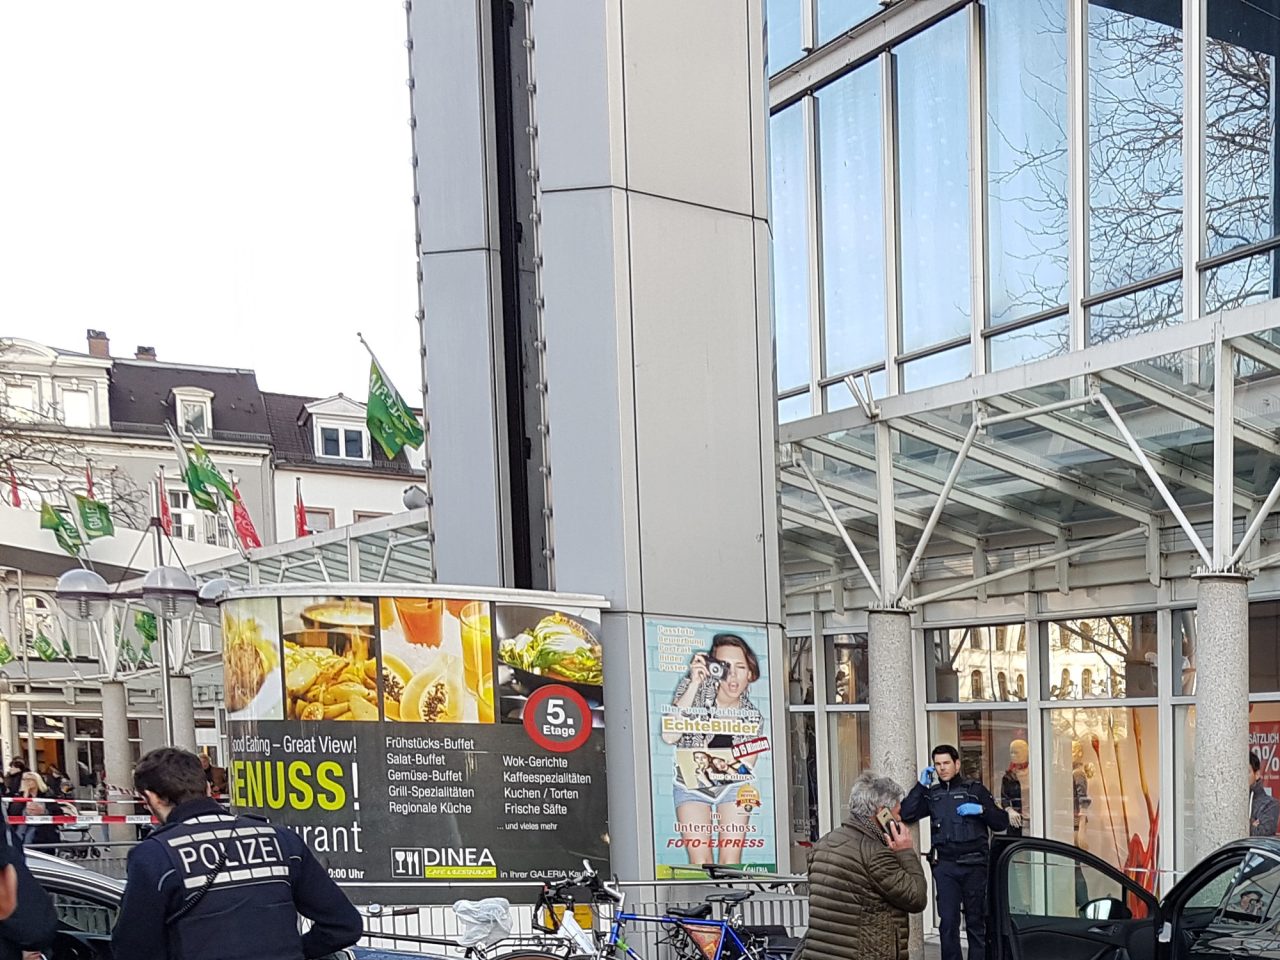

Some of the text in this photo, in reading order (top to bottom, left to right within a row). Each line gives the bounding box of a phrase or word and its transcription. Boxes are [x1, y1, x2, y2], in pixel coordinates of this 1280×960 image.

[546, 699, 575, 725] 5.
[543, 725, 576, 738] Etage
[246, 736, 271, 757] Eating
[283, 735, 317, 753] Great
[318, 735, 358, 754] View!
[385, 736, 475, 751] Frühstücks-Buffet
[386, 752, 446, 766] Salat-Buffet
[502, 755, 569, 769] Wok-Gerichte
[387, 769, 463, 782] Gemüse-Buffet
[503, 771, 592, 785] Kaffeespezialitäten
[388, 785, 475, 799] Grill-Spezialitäten
[504, 787, 541, 799] Kuchen
[550, 787, 579, 800] Torten
[389, 801, 472, 815] Regionale Küche
[505, 802, 568, 815] Frische Säfte
[520, 822, 540, 830] vieles
[540, 822, 558, 831] mehr
[674, 823, 757, 835] Untergeschoss
[667, 838, 765, 849] FOTO-EXPRESS
[178, 837, 284, 874] POLIZEI
[424, 847, 497, 867] DINEA
[348, 868, 365, 879] Uhr
[500, 871, 508, 879] in
[509, 871, 529, 879] Ihrer
[530, 870, 567, 879] GALERIA
